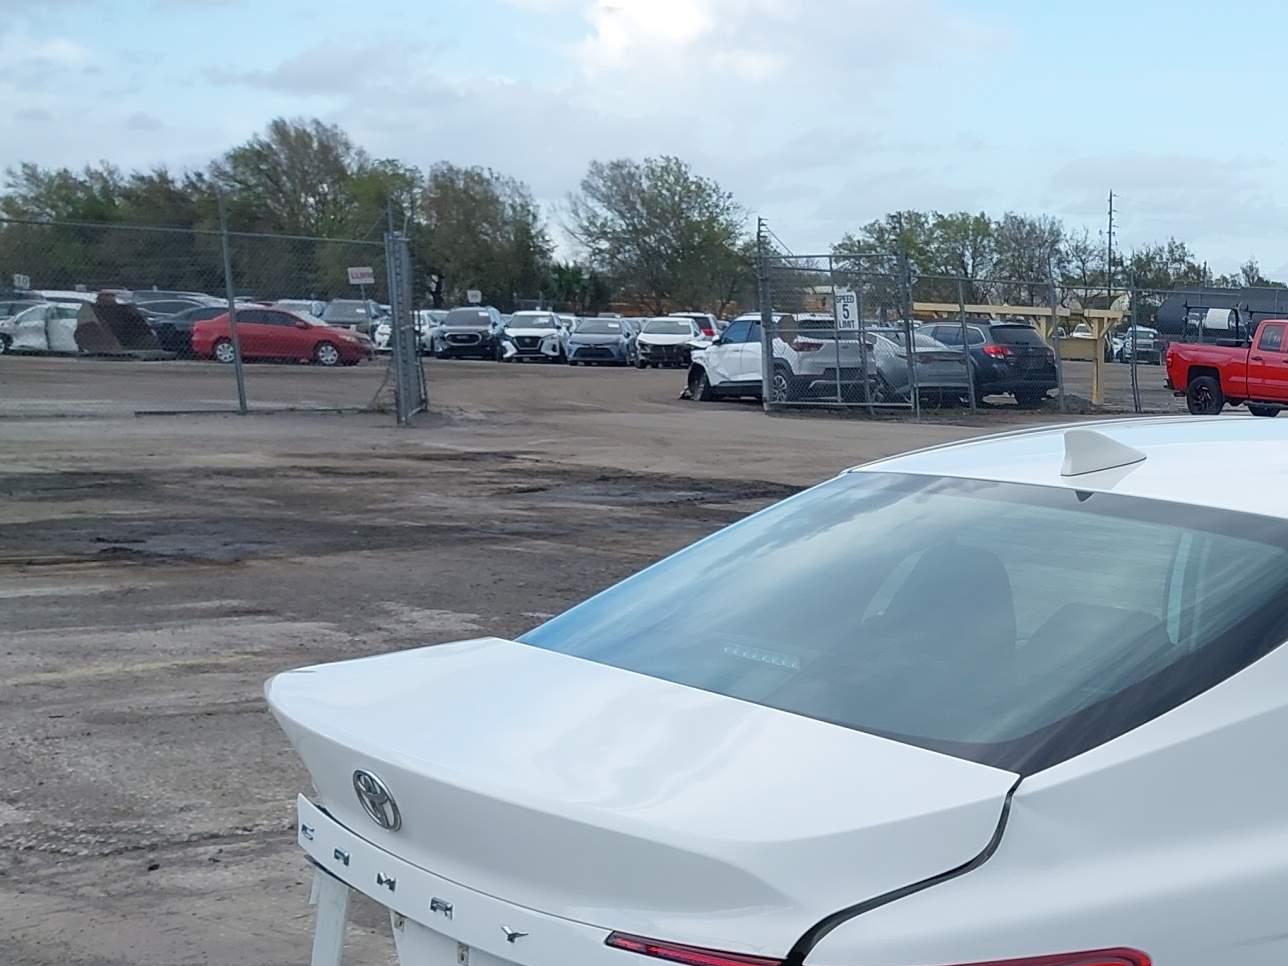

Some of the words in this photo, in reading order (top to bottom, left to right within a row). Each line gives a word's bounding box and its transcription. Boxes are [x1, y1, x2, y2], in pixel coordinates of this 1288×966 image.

[835, 295, 855, 304] SPEED
[842, 304, 850, 319] 5
[838, 320, 856, 329] LIMIT
[301, 823, 529, 944] CAMRY
